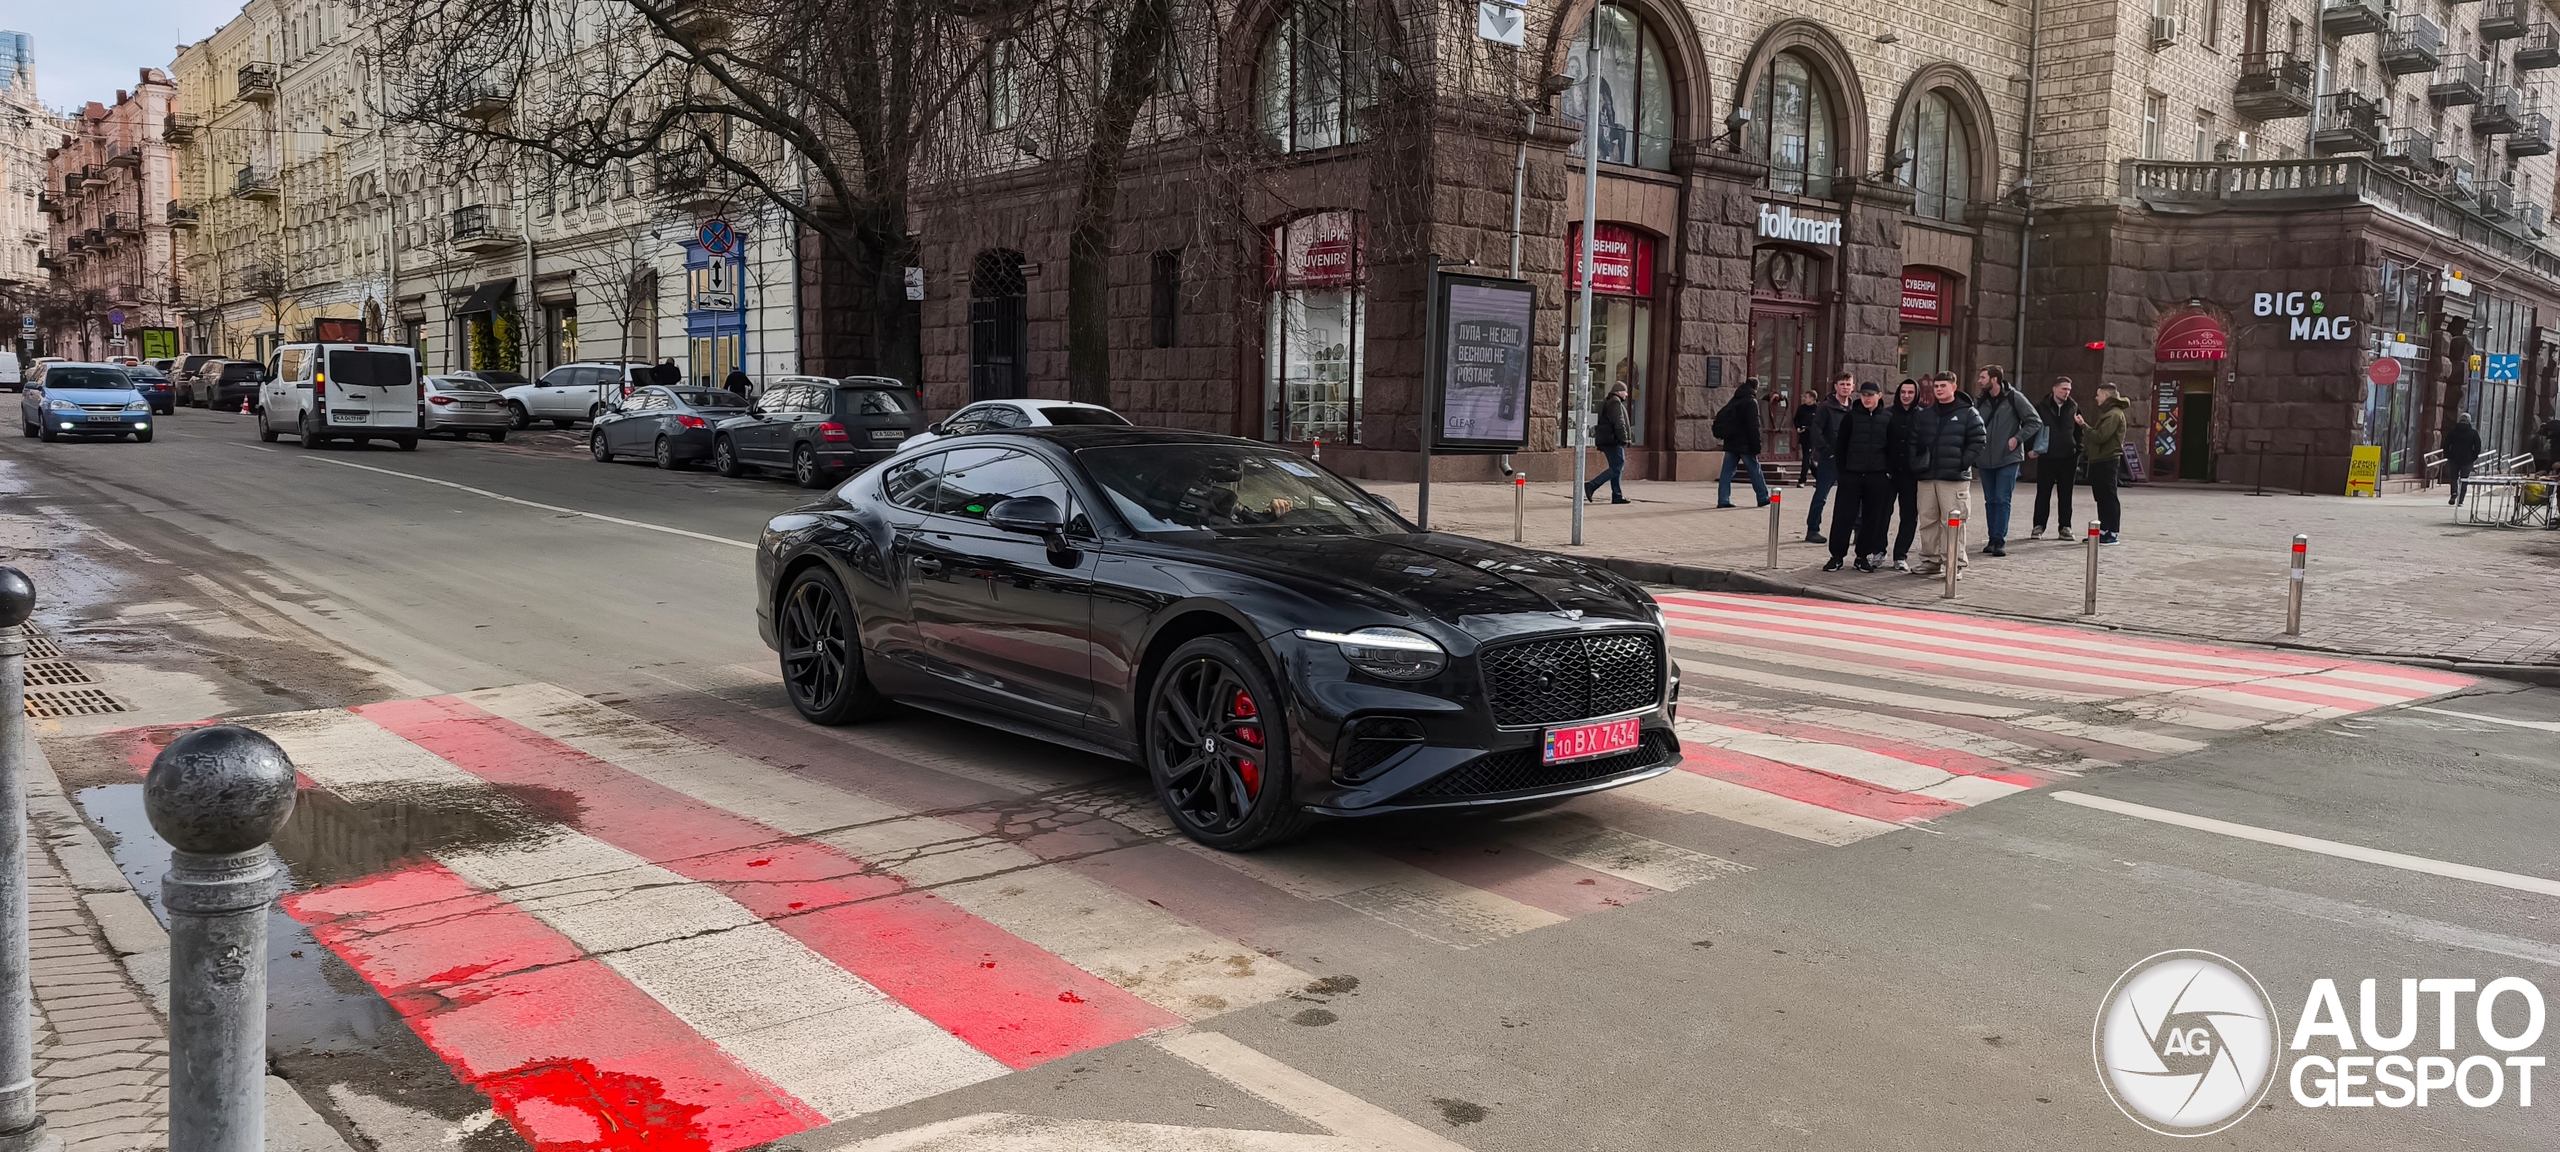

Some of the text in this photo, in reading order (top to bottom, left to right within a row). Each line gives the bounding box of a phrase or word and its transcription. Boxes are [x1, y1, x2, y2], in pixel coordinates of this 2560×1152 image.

[1758, 202, 1842, 247] folkmart
[1581, 239, 1627, 255] ВЕНІРИ
[1291, 251, 1347, 268] SOUVENIRS
[1577, 260, 1629, 278] SUVENIRS
[1905, 278, 1936, 292] СУВЕНІРИ
[1902, 296, 1937, 310] SOUVENIRS
[2253, 291, 2305, 316] BIG
[1458, 324, 1481, 341] ЛУПА
[1489, 326, 1500, 343] НЕ
[1500, 327, 1520, 346] СНІГ,
[2289, 316, 2352, 341] MAG
[1458, 345, 1505, 364] ВЕСНОЮ НЕ
[2169, 350, 2213, 359] BEAUTY
[1457, 366, 1495, 384] РОЗТАНЕ.
[1448, 415, 1475, 428] CLEAR
[1205, 738, 1215, 753] B
[1556, 721, 1635, 756] 10 BX 7434
[1546, 748, 1554, 758] UA
